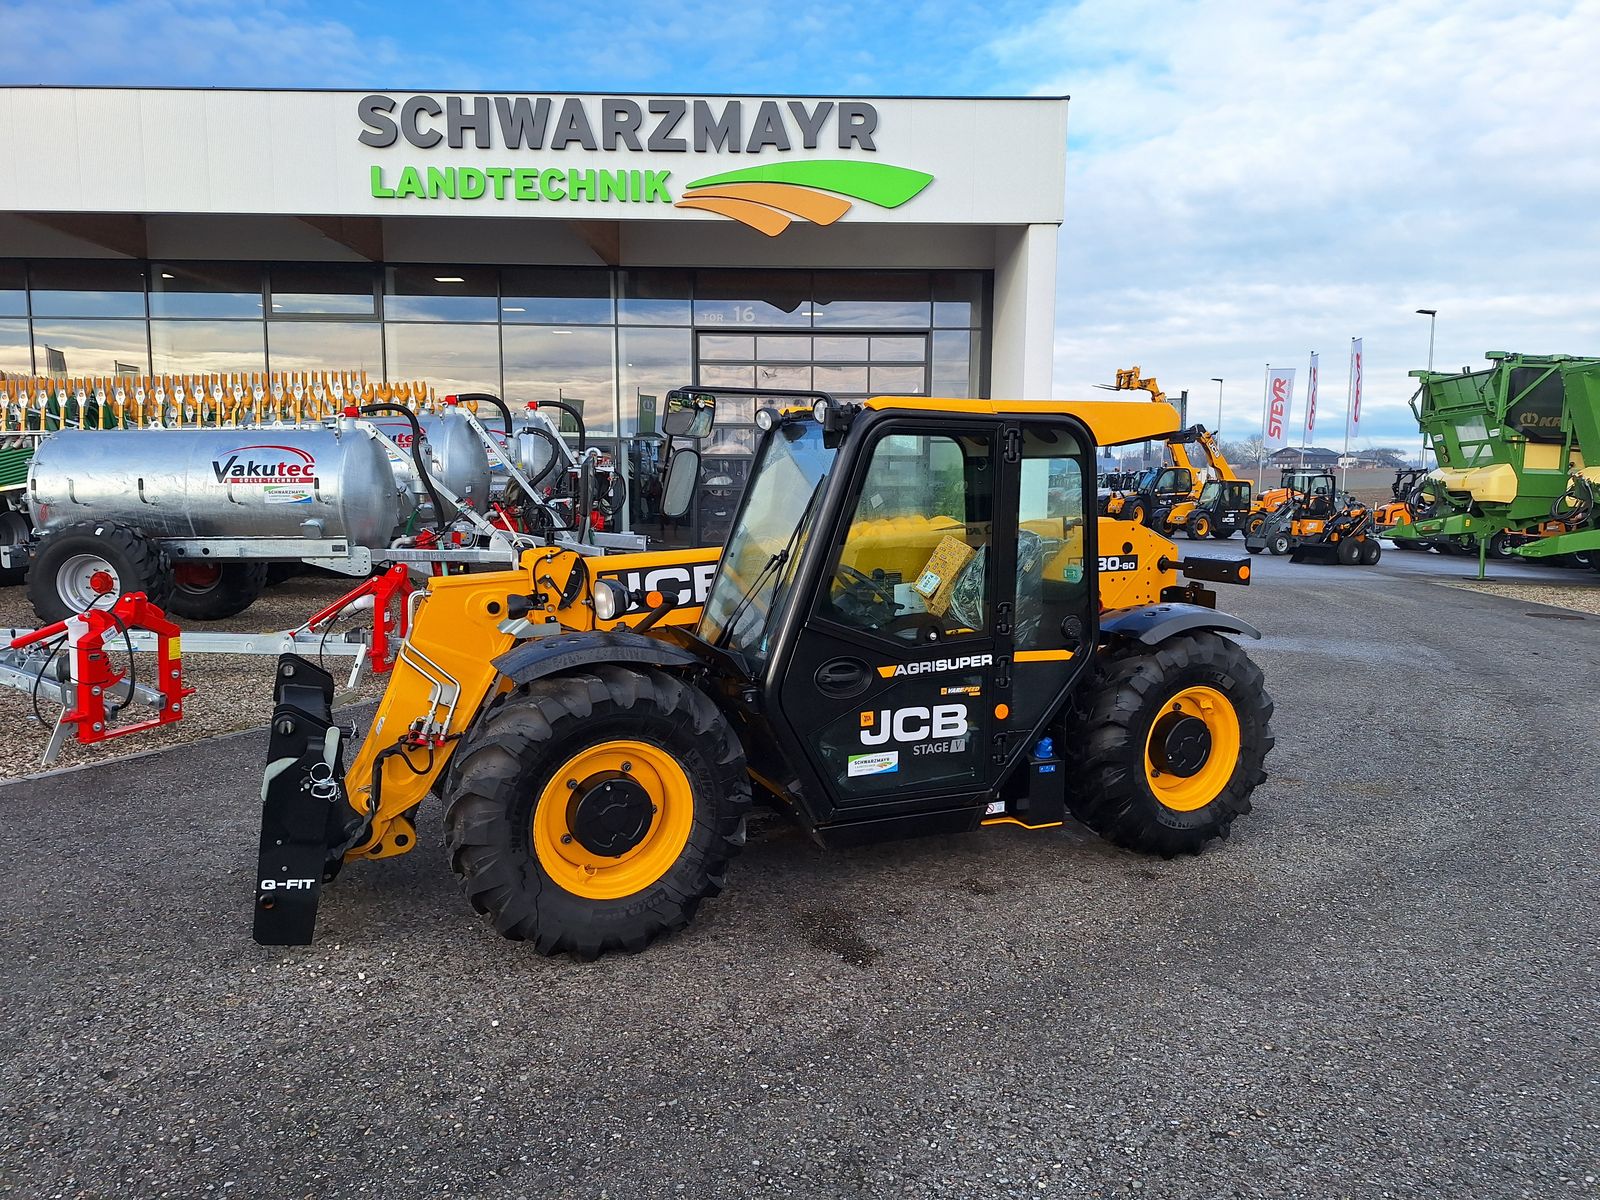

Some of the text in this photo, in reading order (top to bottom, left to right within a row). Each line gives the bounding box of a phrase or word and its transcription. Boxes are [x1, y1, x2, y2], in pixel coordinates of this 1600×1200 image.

[357, 94, 878, 153] SCHWARZMAYR
[370, 165, 673, 203] LANDTECHNIK
[703, 305, 756, 322] TOR 16
[1268, 377, 1287, 440] STEYR
[212, 455, 315, 483] Vakutec
[894, 654, 993, 677] AGRISUPER
[860, 703, 968, 746] JCB
[913, 742, 949, 756] STAGE
[260, 879, 316, 890] Q-FIT
